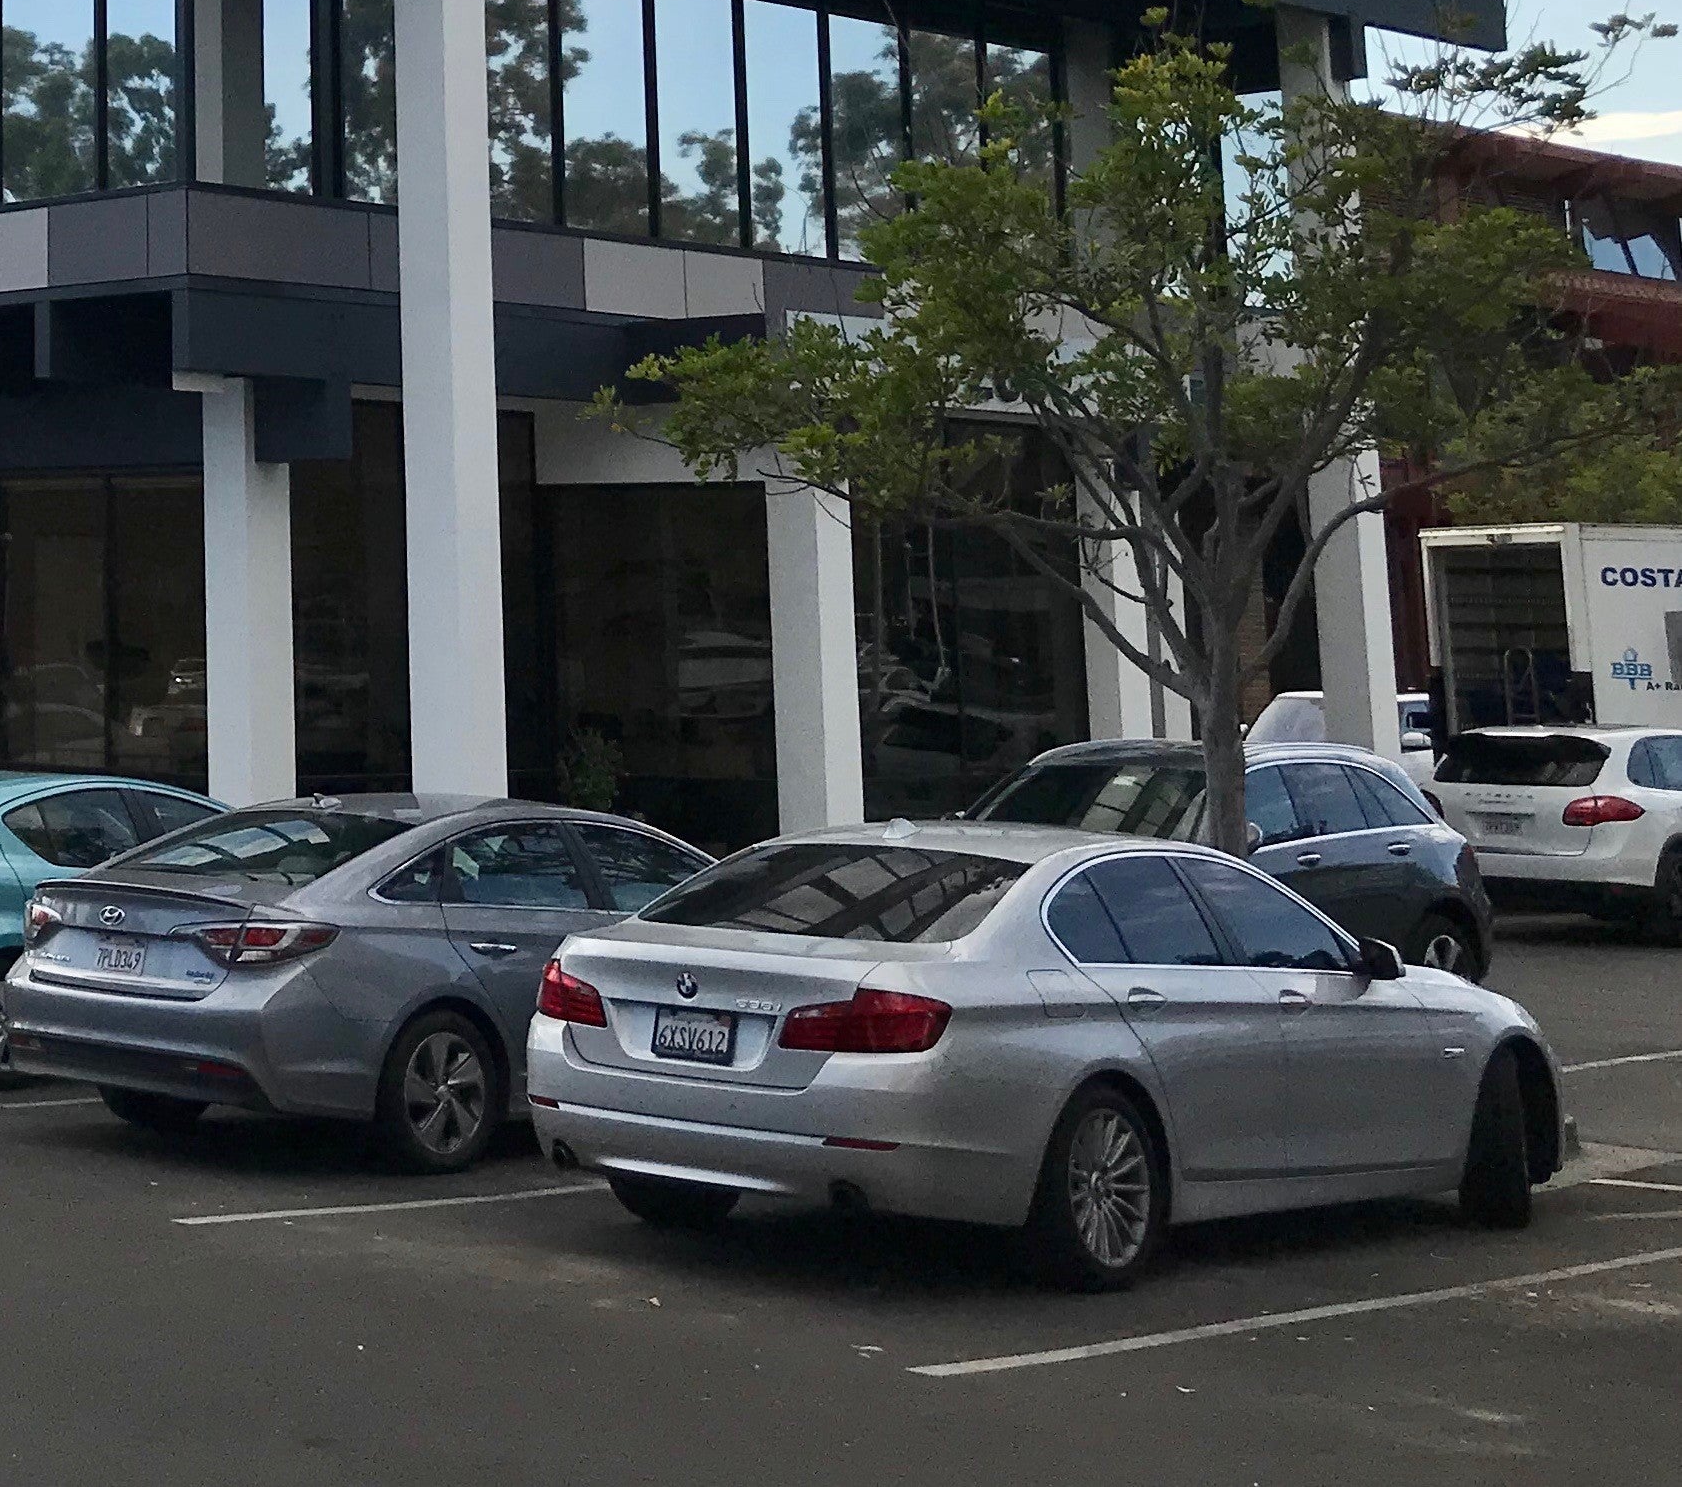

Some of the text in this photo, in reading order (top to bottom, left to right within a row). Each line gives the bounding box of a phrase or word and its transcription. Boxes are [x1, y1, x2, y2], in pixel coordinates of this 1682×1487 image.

[1611, 662, 1652, 677] BBB
[1664, 681, 1682, 691] Ra
[658, 1024, 727, 1053] 6XSV612
